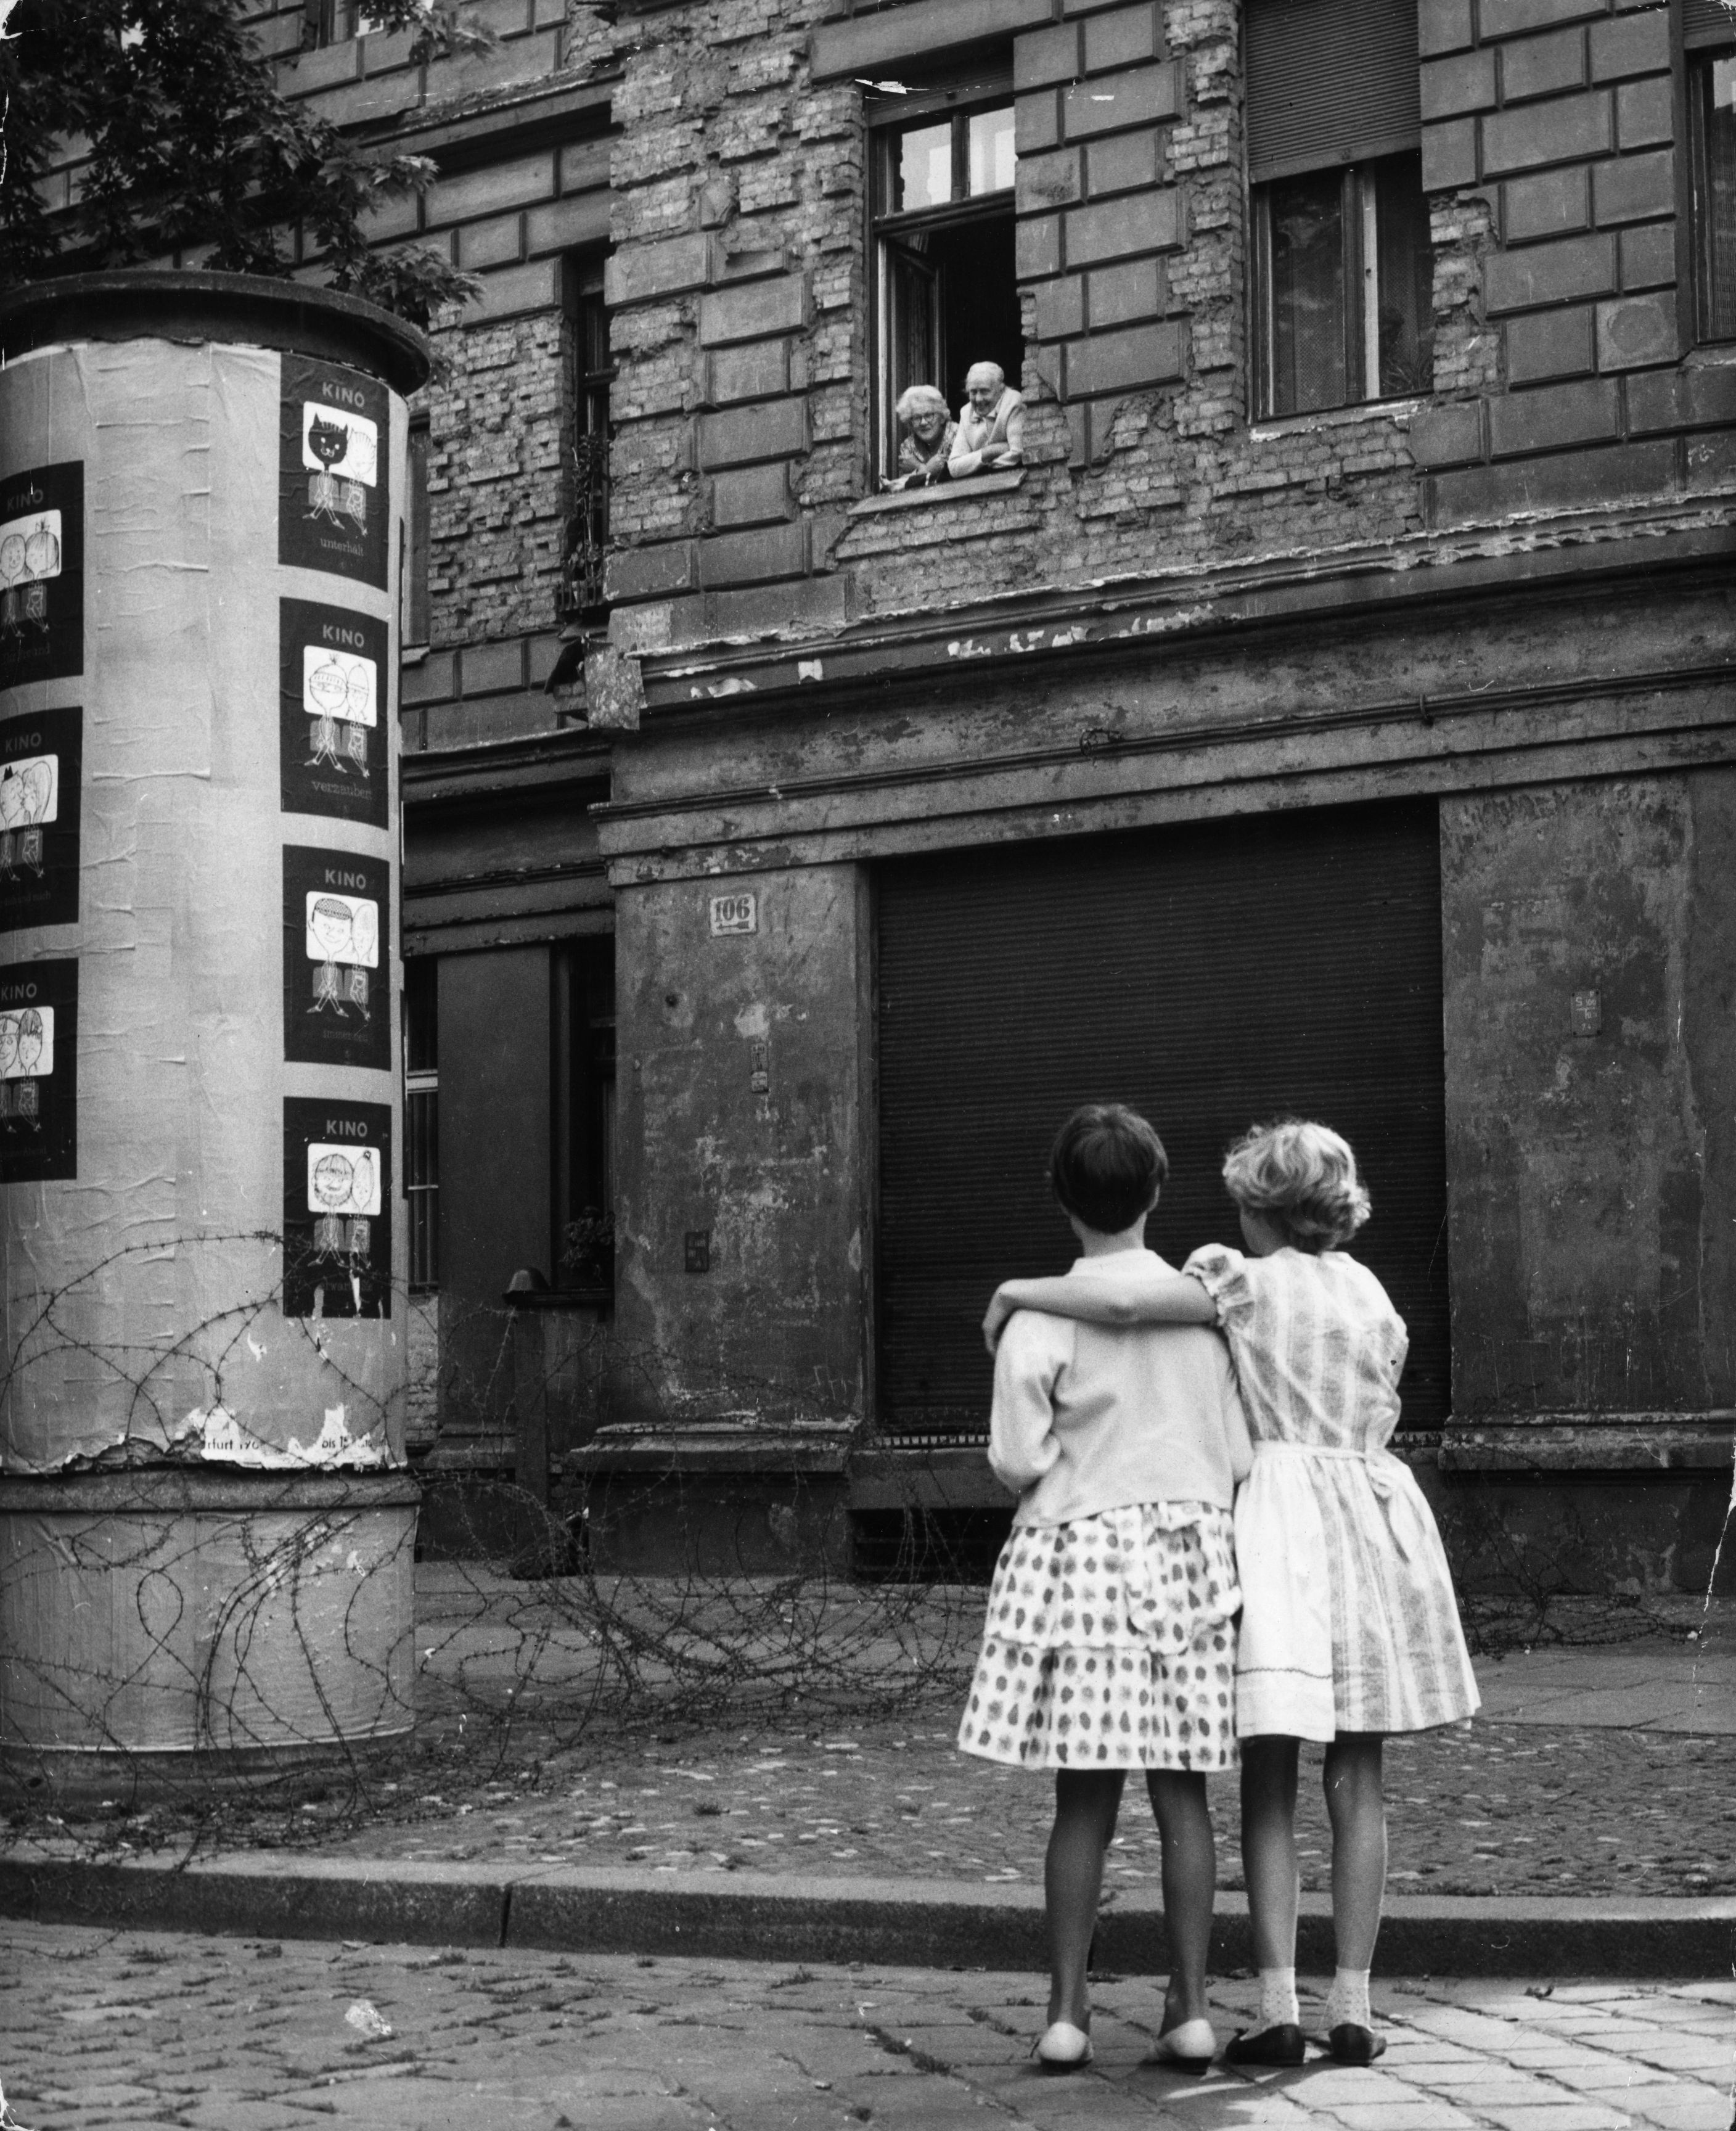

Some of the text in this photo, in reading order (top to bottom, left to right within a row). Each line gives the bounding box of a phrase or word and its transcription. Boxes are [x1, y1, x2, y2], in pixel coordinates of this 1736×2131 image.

[322, 382, 365, 408] KINO
[7, 488, 44, 513] KINO
[322, 624, 365, 649] KINO
[5, 732, 42, 753] KINO
[325, 868, 367, 890] KINO
[714, 897, 750, 922] 106
[1, 982, 38, 1001] KINO
[326, 1119, 368, 1138] KINO
